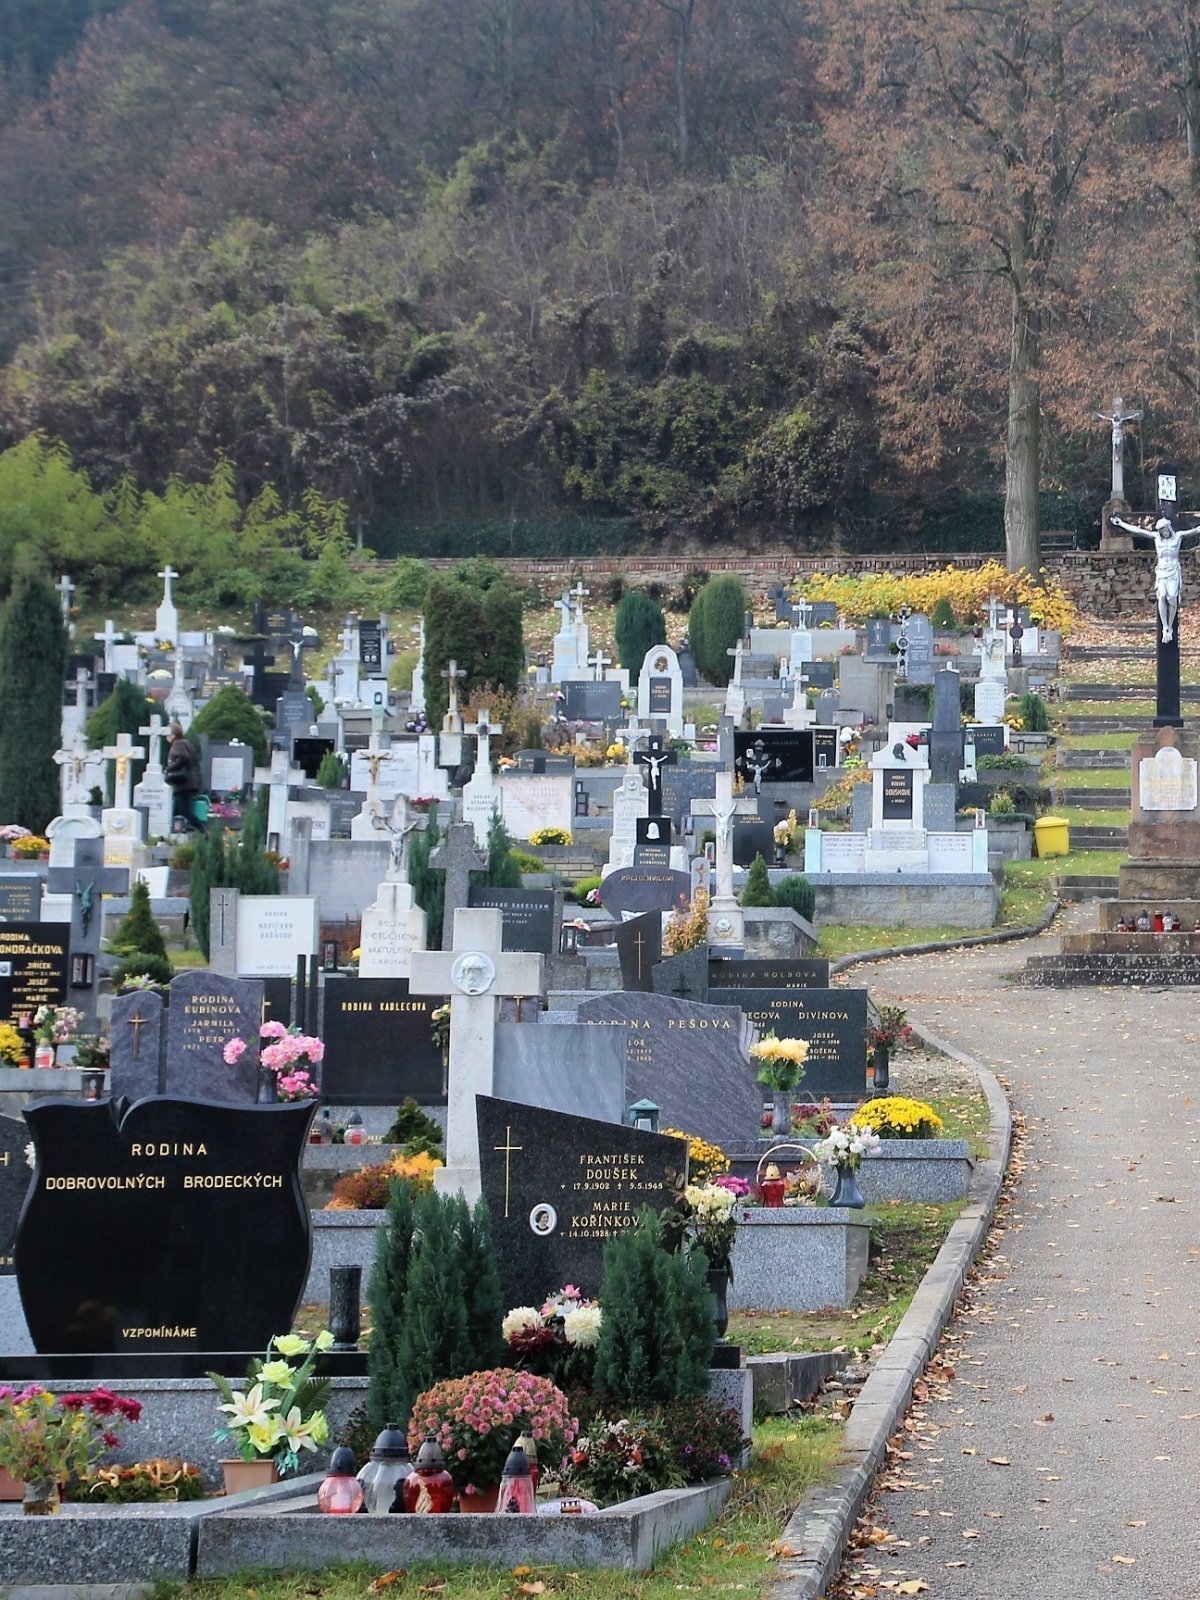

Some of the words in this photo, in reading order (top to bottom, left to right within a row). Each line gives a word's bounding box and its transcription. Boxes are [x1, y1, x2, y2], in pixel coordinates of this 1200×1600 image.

[184, 1006, 241, 1014] KUBINOVA
[342, 1002, 373, 1011] RODINA
[748, 1012, 780, 1020] ECOVA
[798, 1010, 849, 1020] DIVÍNOVA
[668, 1018, 730, 1029] PEŠOVA
[131, 1143, 208, 1157] RODINA
[579, 1153, 645, 1165] FRANTIŠEK
[586, 1167, 638, 1180] DOUŠEK
[45, 1173, 165, 1190] DOBROVOLNÝCH
[183, 1172, 283, 1188] BRODECKÝCH
[573, 1182, 610, 1190] 17.9.1902
[592, 1201, 631, 1212] MARIE
[571, 1214, 645, 1228] KOŘÍNKOV
[122, 1326, 197, 1339] VZPOMÍNÁME
